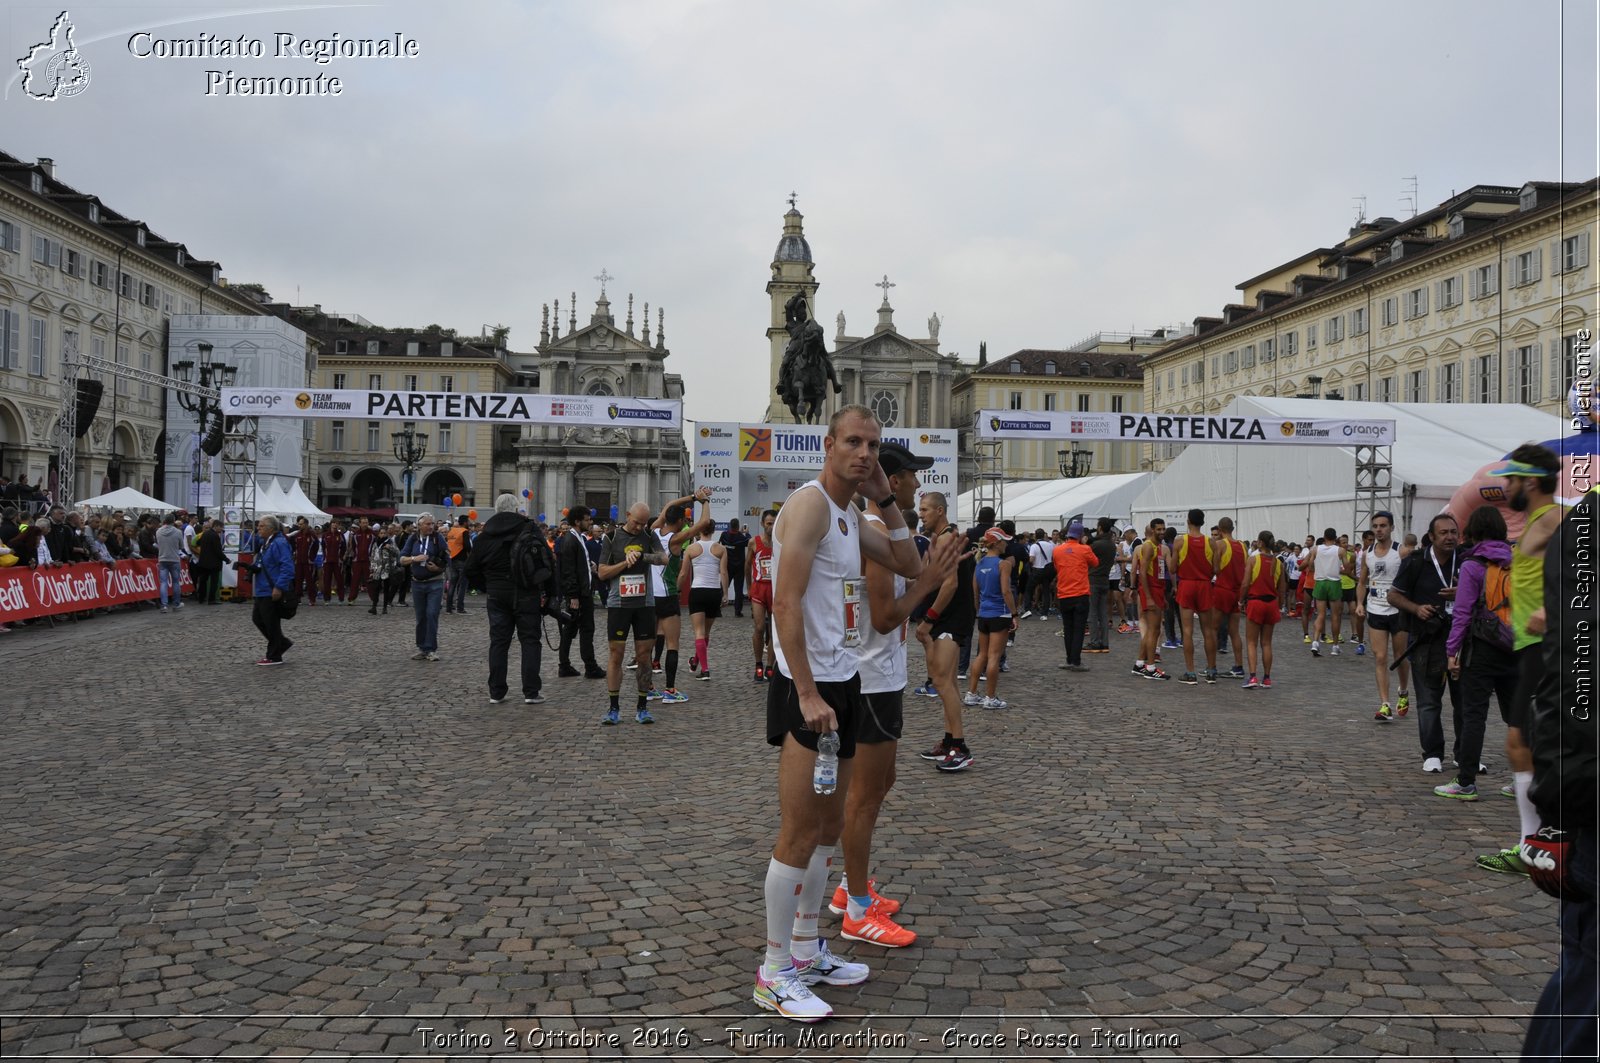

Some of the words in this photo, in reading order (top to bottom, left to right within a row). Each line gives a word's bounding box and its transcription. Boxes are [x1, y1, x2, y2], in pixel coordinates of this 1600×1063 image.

[312, 393, 332, 401] TEAM
[312, 401, 352, 410] MARATHON
[367, 392, 531, 419] PARTENZA
[565, 403, 594, 411] REGIONE
[1119, 415, 1267, 440] PARTENZA
[1295, 429, 1329, 437] MARATHON
[774, 433, 822, 451] TURIN
[774, 454, 805, 463] GRAN
[808, 455, 826, 464] PRI
[704, 465, 730, 478] iren
[923, 471, 949, 484] iren
[50, 571, 100, 604] UniCredit
[625, 584, 640, 595] 217
